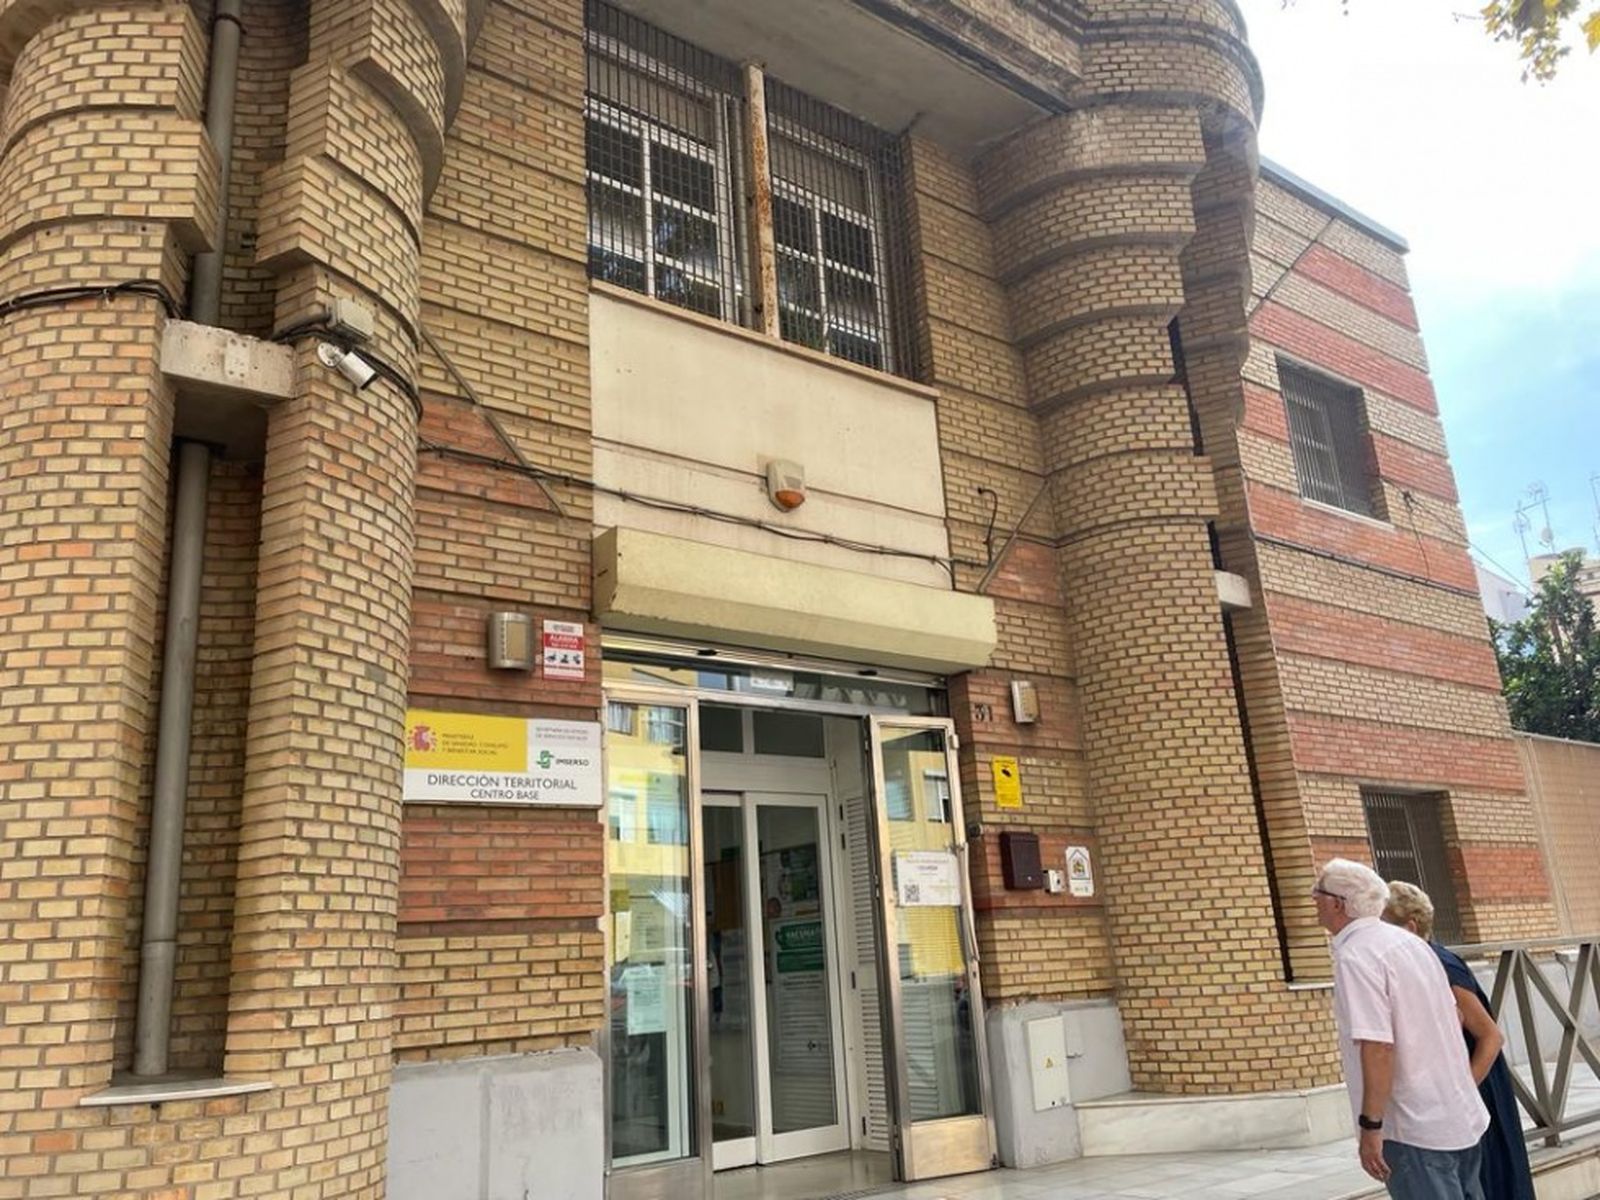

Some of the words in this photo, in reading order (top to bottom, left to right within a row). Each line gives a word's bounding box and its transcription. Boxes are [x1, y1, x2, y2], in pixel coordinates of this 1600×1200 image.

[555, 758, 590, 767] IMSERSO
[427, 774, 499, 787] DIRECCIÓN
[504, 776, 577, 790] TERRITORIAL
[470, 788, 514, 799] CENTRO
[516, 790, 539, 800] BASE
